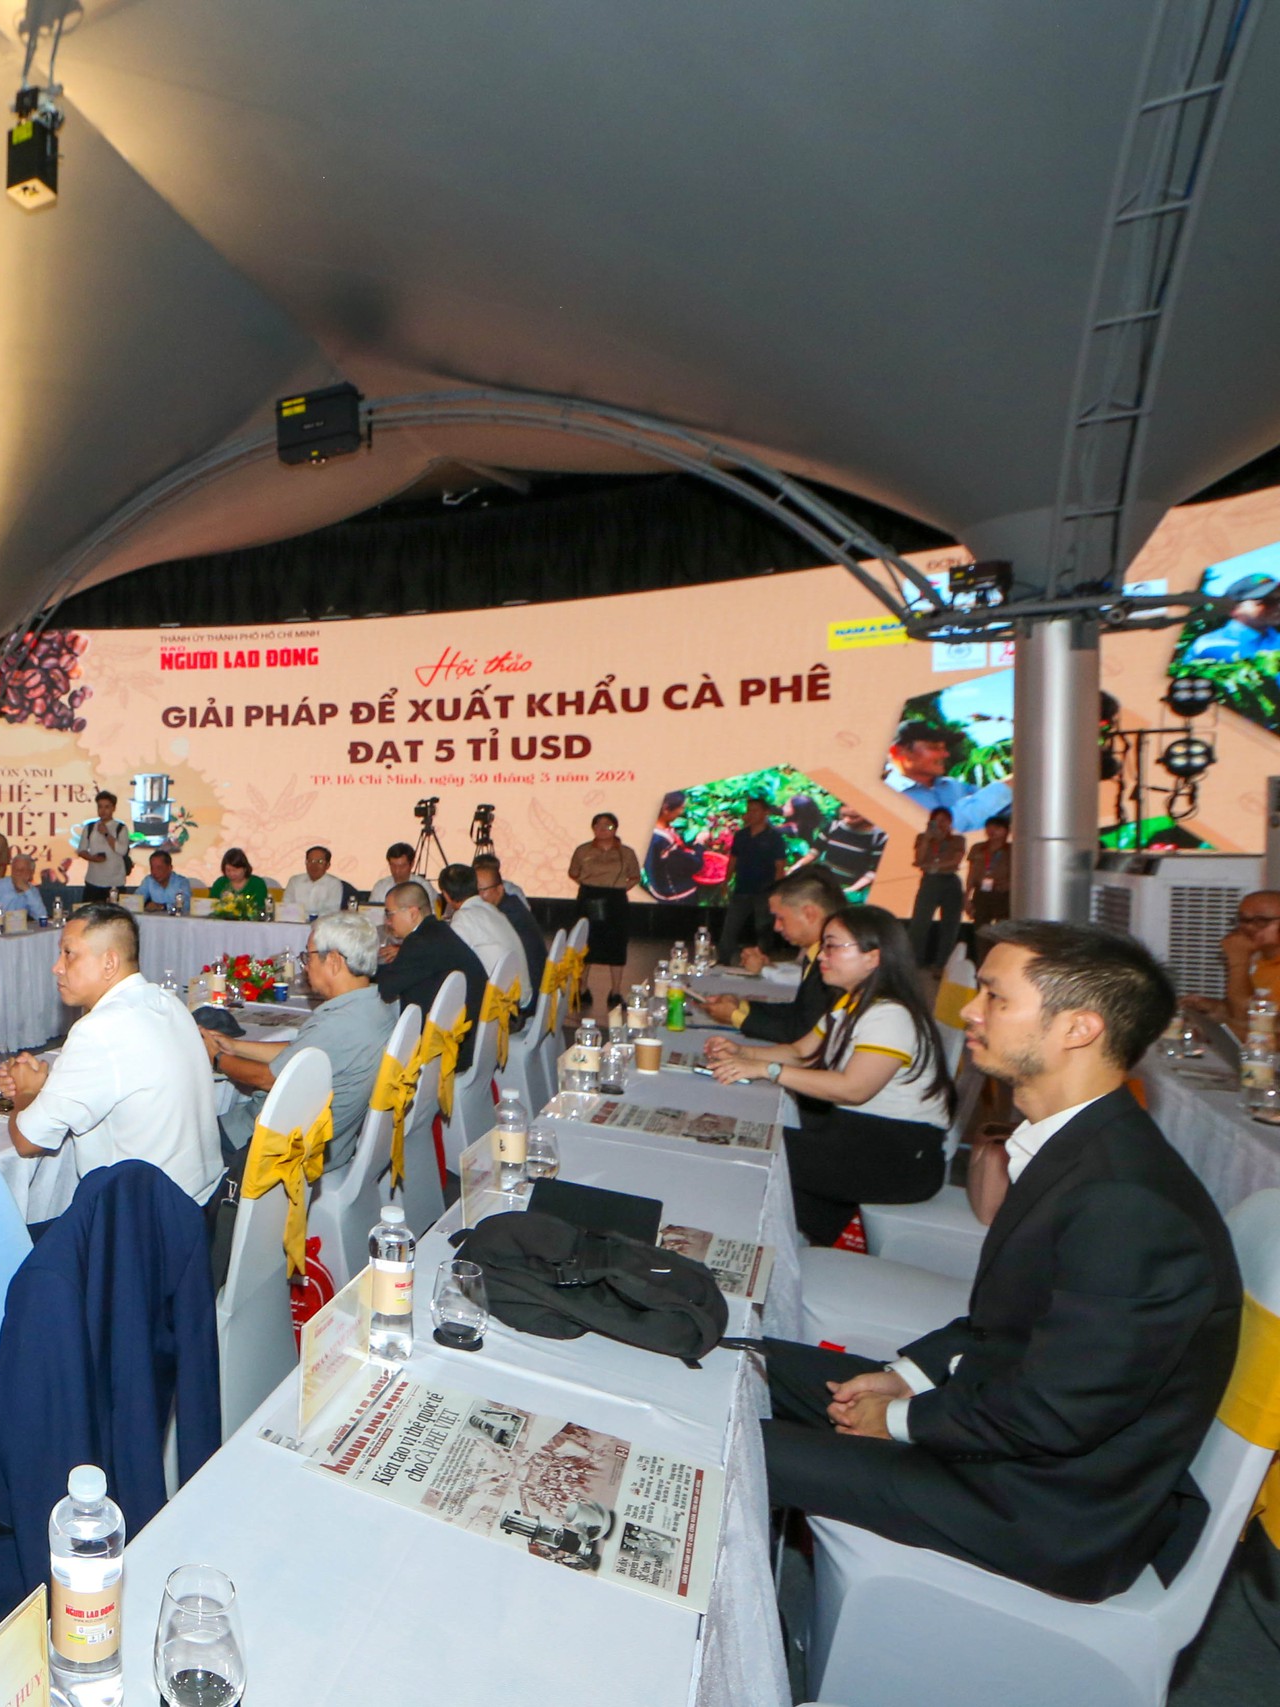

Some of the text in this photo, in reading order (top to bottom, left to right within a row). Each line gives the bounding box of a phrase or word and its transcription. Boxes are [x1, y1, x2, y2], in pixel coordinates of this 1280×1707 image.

[224, 650, 260, 669] LAO
[415, 646, 533, 687] Hội thảo
[161, 663, 831, 728] GIẢI PHÁP ĐỂ XUẤT KHẨU CÀ PHÊ
[347, 728, 592, 769] ĐẠT 5 TỈ USD
[23, 768, 53, 777] VINH
[310, 775, 332, 786] TP.
[430, 773, 465, 787] ngày
[470, 772, 489, 784] 30
[493, 772, 535, 786] tháng
[540, 772, 550, 782] 3
[555, 771, 589, 782] năm
[595, 770, 635, 782] 2024
[0, 805, 68, 842] IỆT
[427, 1390, 445, 1404] tế
[417, 1402, 439, 1423] quốc
[433, 1407, 461, 1430] VIỆT
[404, 1420, 425, 1440] thế
[422, 1427, 448, 1451] PHÊ
[399, 1434, 421, 1447] vị
[389, 1445, 411, 1464] tạo
[413, 1448, 434, 1465] CÀ
[372, 1457, 400, 1486] Kiến
[404, 1462, 429, 1482] cho
[86, 1610, 99, 1618] LAO
